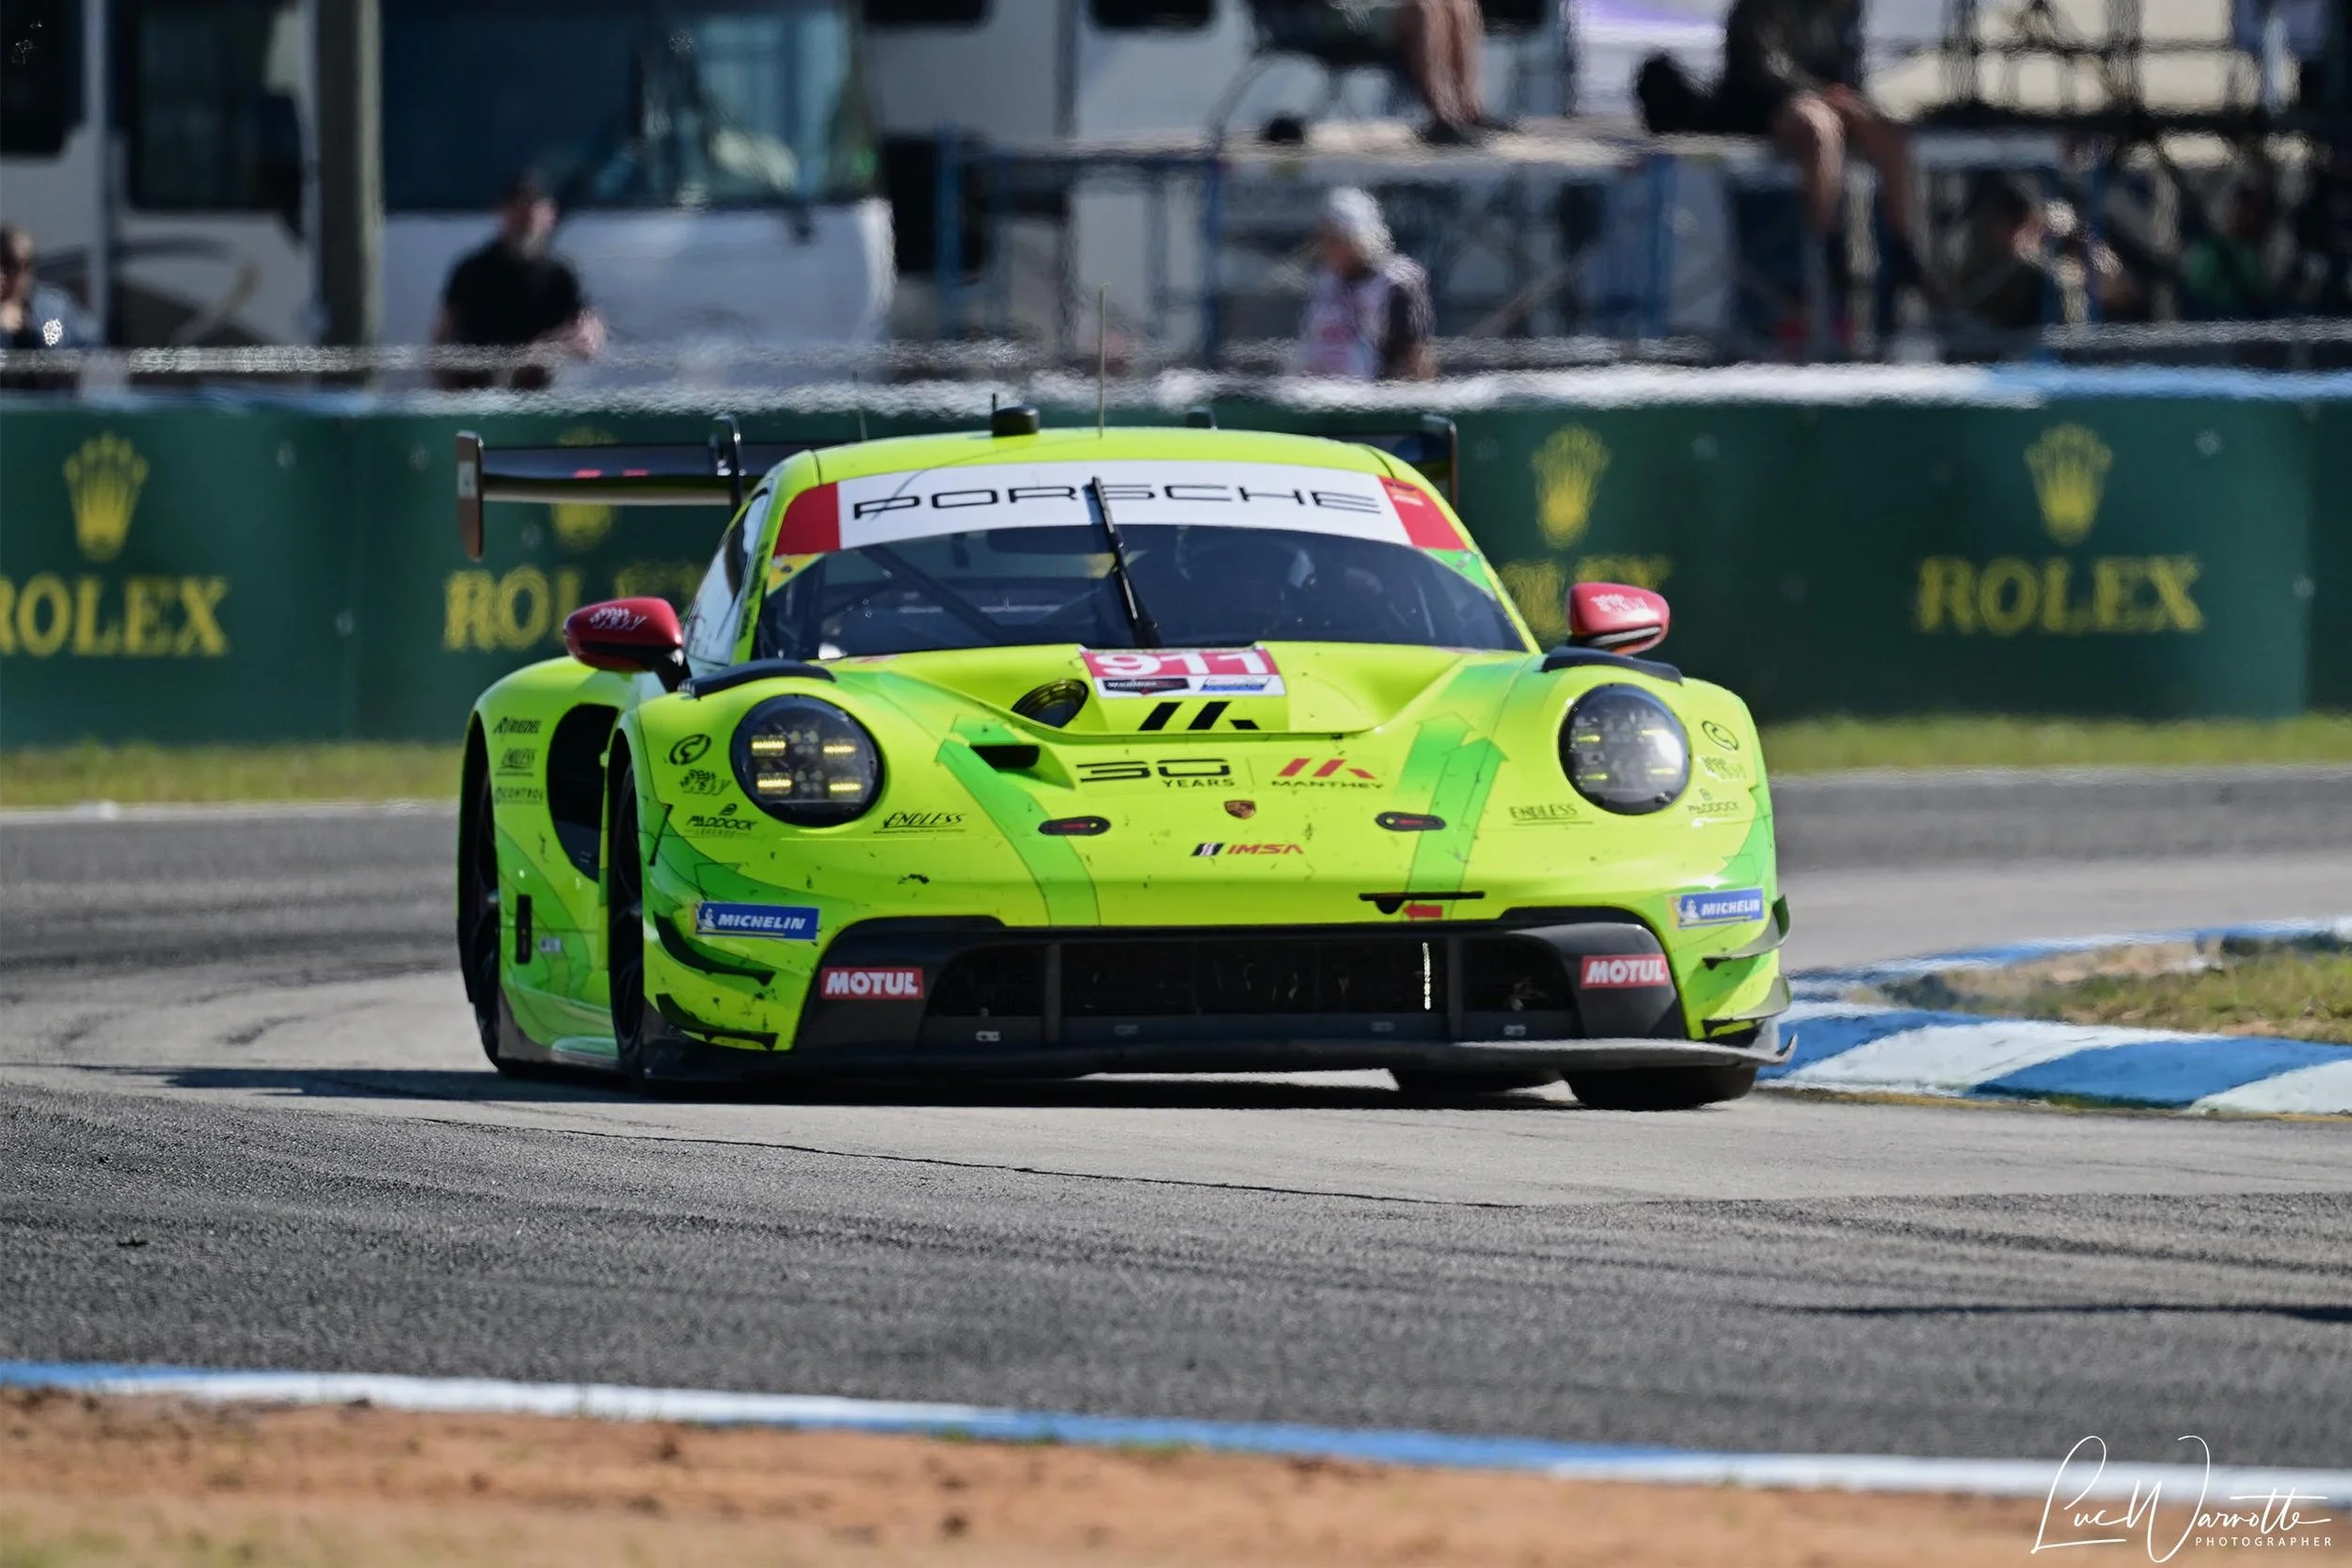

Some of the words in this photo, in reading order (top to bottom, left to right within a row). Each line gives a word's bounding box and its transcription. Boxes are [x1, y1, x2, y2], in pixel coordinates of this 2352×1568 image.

[853, 483, 1382, 520] PORSCHE
[1919, 555, 2203, 636] ROLEX
[1095, 652, 1269, 676] 911
[1162, 778, 1236, 788] YEARS
[1271, 780, 1386, 790] MANTHEY
[883, 812, 967, 828] ENDLESS
[1508, 803, 1579, 820] ENDLESS
[685, 815, 758, 831] PADDOCK
[1227, 844, 1305, 855] IMSA
[1700, 898, 1761, 917] MICHELIN
[717, 912, 806, 931] MICHELIN
[1584, 958, 1667, 986] MOTUL
[824, 971, 918, 995] MOTUL
